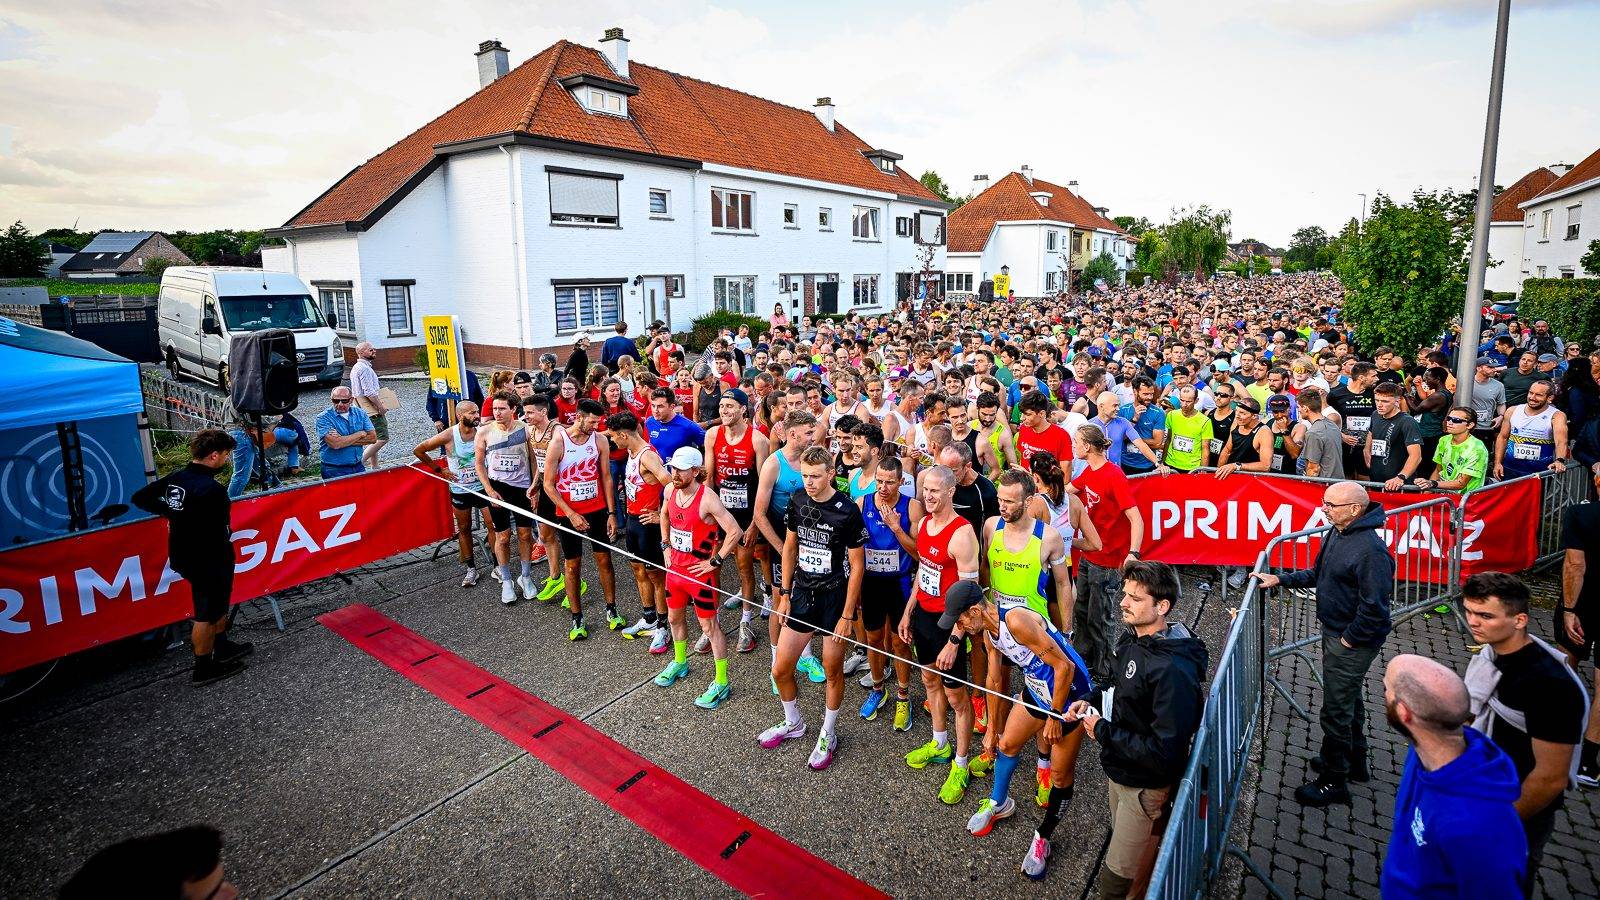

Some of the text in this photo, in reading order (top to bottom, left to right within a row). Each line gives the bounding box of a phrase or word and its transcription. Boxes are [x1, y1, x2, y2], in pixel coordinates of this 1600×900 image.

[429, 325, 450, 346] START
[436, 348, 450, 369] BOX
[1178, 440, 1187, 448] 63
[1516, 448, 1536, 456] 1081
[575, 486, 595, 496] 1250
[674, 535, 683, 545] 79
[805, 548, 830, 556] PRIMAGAZ
[805, 555, 822, 566] 429
[873, 557, 891, 565] 544
[921, 573, 930, 585] 66
